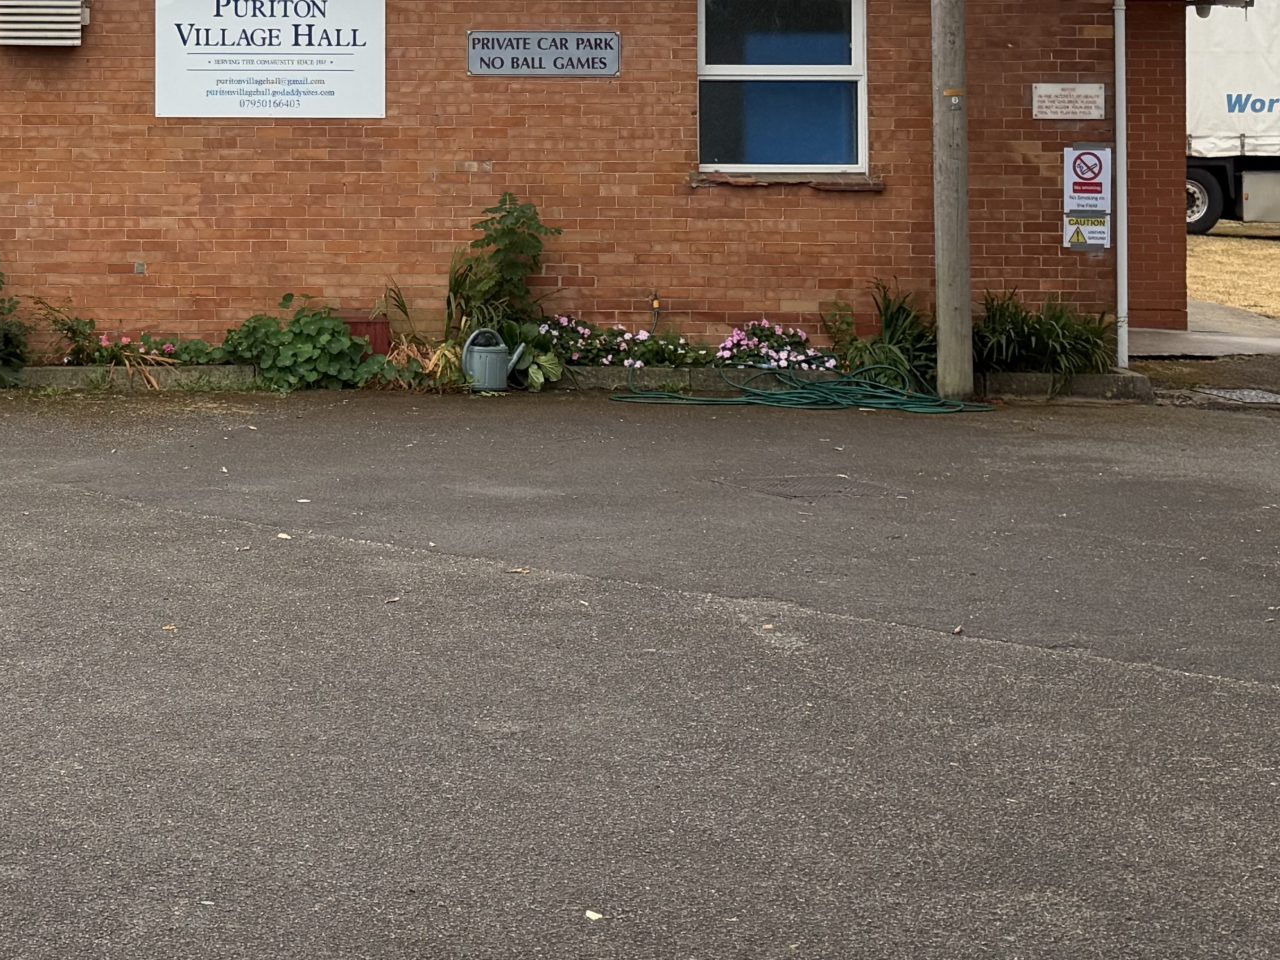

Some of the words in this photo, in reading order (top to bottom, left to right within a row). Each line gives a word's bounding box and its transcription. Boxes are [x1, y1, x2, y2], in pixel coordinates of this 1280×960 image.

[174, 23, 282, 47] VILLAGE
[291, 23, 367, 47] HALL
[472, 37, 531, 51] PRIVATE
[537, 37, 569, 51] CAR
[576, 37, 614, 50] PARK
[214, 58, 240, 66] SERVING
[256, 58, 295, 66] COMMUNITY
[479, 56, 505, 70] NO
[511, 57, 546, 69] BALL
[553, 56, 607, 70] GAMES
[216, 77, 326, 87] puritonvillagehall@gmail.com
[239, 99, 301, 109] 07950166403
